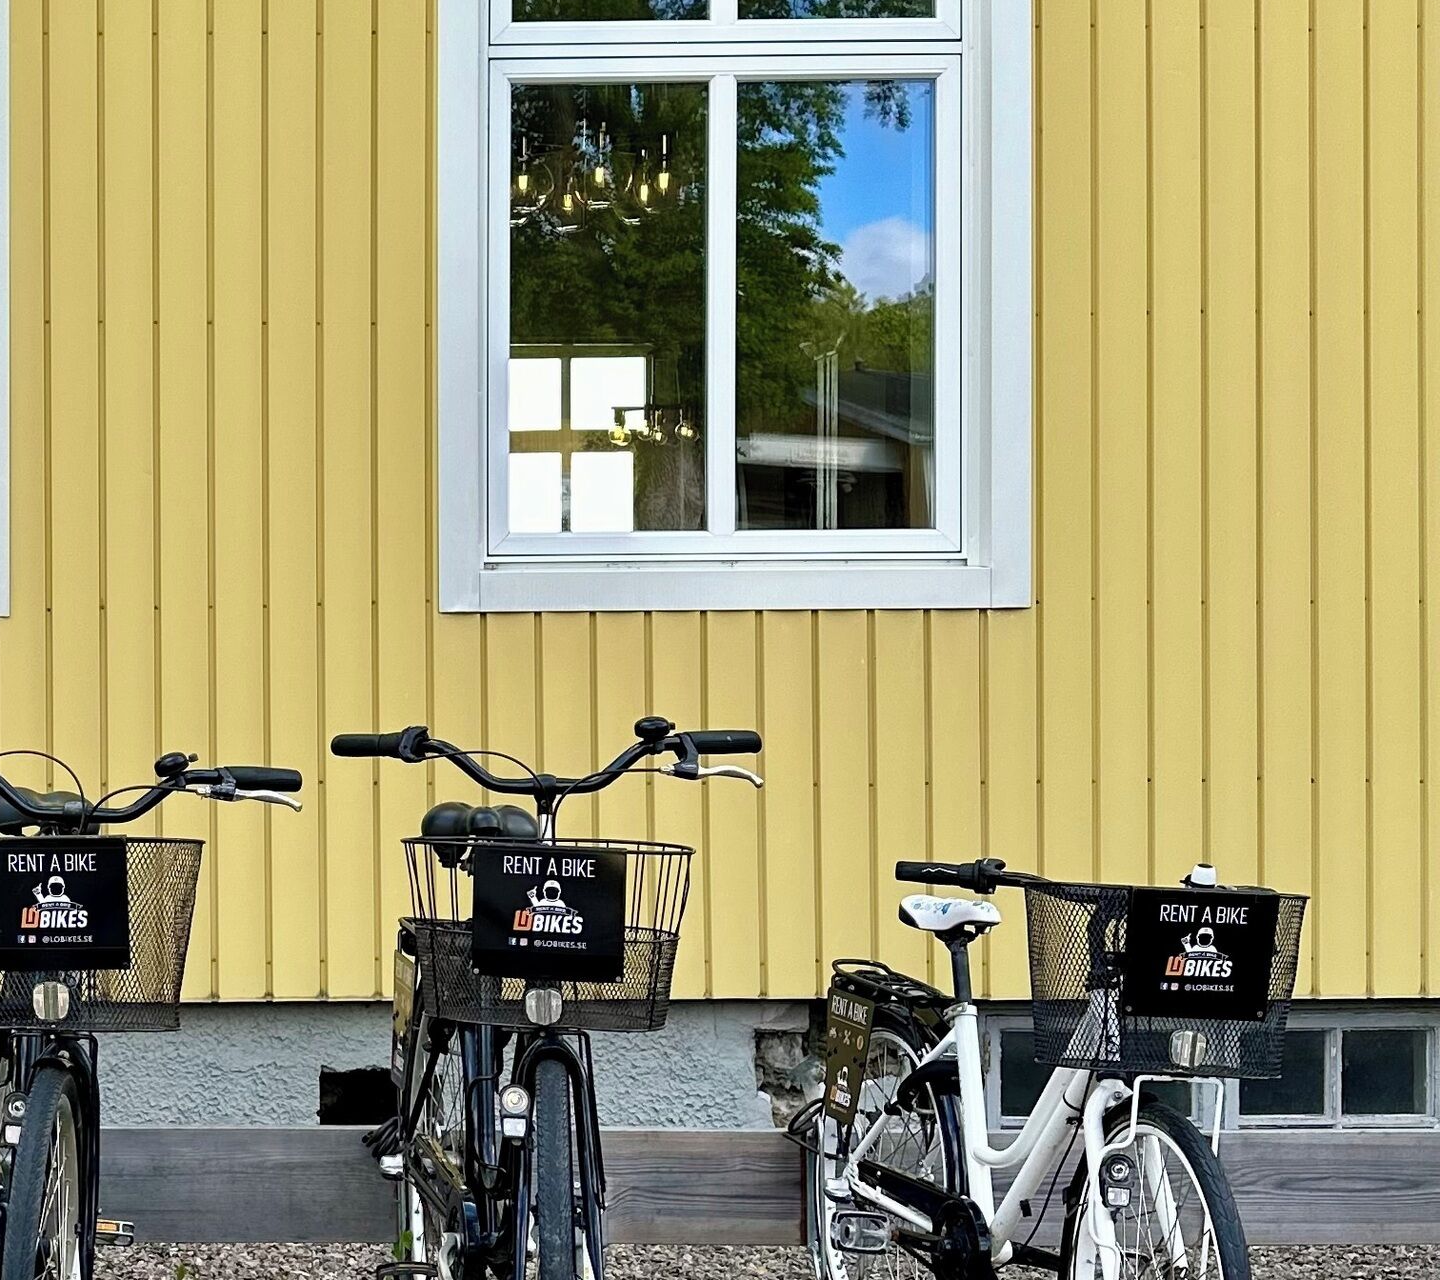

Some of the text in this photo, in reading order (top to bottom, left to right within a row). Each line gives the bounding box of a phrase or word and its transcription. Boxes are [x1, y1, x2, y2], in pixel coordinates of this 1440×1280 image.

[7, 853, 97, 872] RENT A BIKE
[503, 855, 596, 878] RENT A BIKE
[1159, 904, 1249, 925] RENT A BIKE
